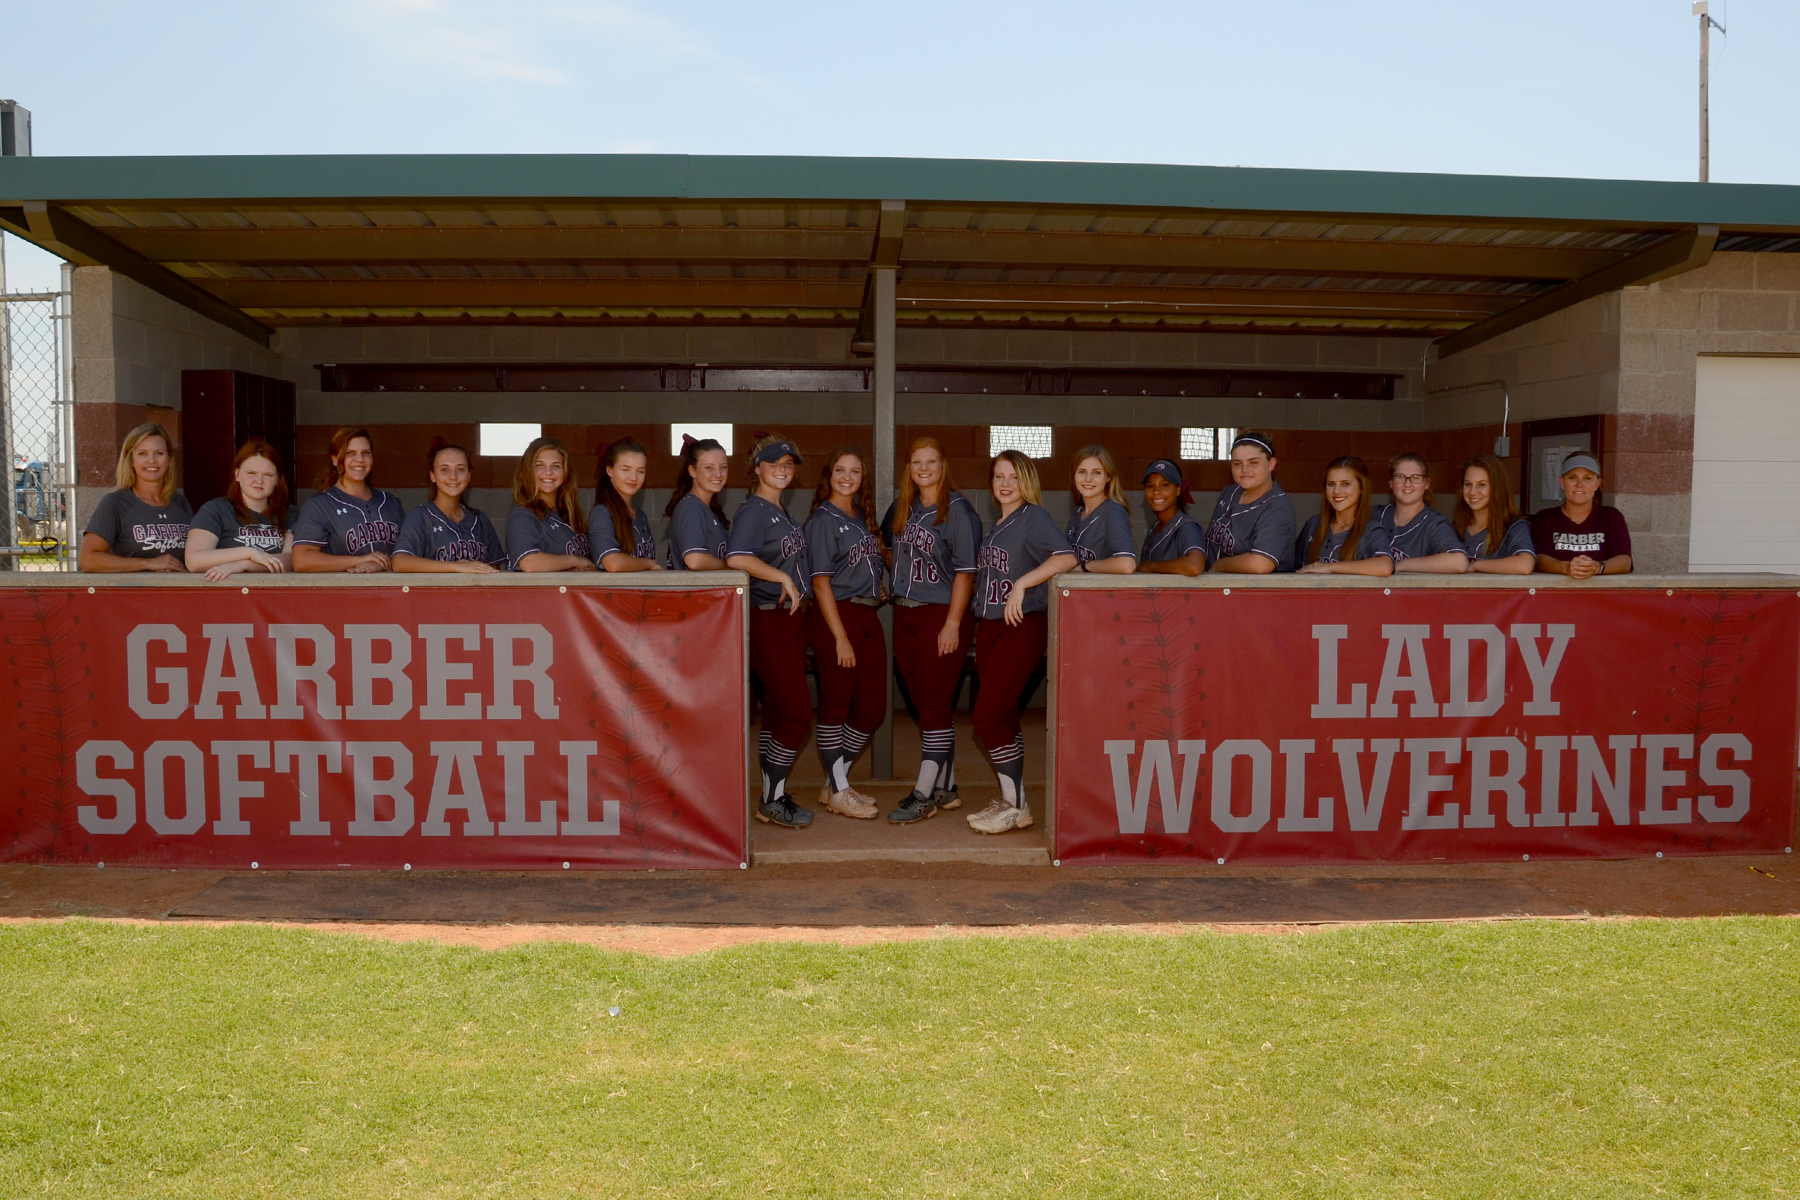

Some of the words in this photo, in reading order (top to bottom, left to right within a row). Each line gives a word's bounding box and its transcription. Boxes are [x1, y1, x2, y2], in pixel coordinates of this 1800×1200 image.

[133, 524, 188, 543] GARBE
[142, 536, 187, 553] Softba
[1553, 532, 1605, 545] GARBER
[913, 557, 940, 583] 16
[988, 579, 1014, 604] 12
[127, 623, 560, 721] GARBER
[1311, 623, 1576, 719] LADY
[76, 740, 621, 837] SOFTBALL
[1103, 733, 1753, 834] WOLVERINES
